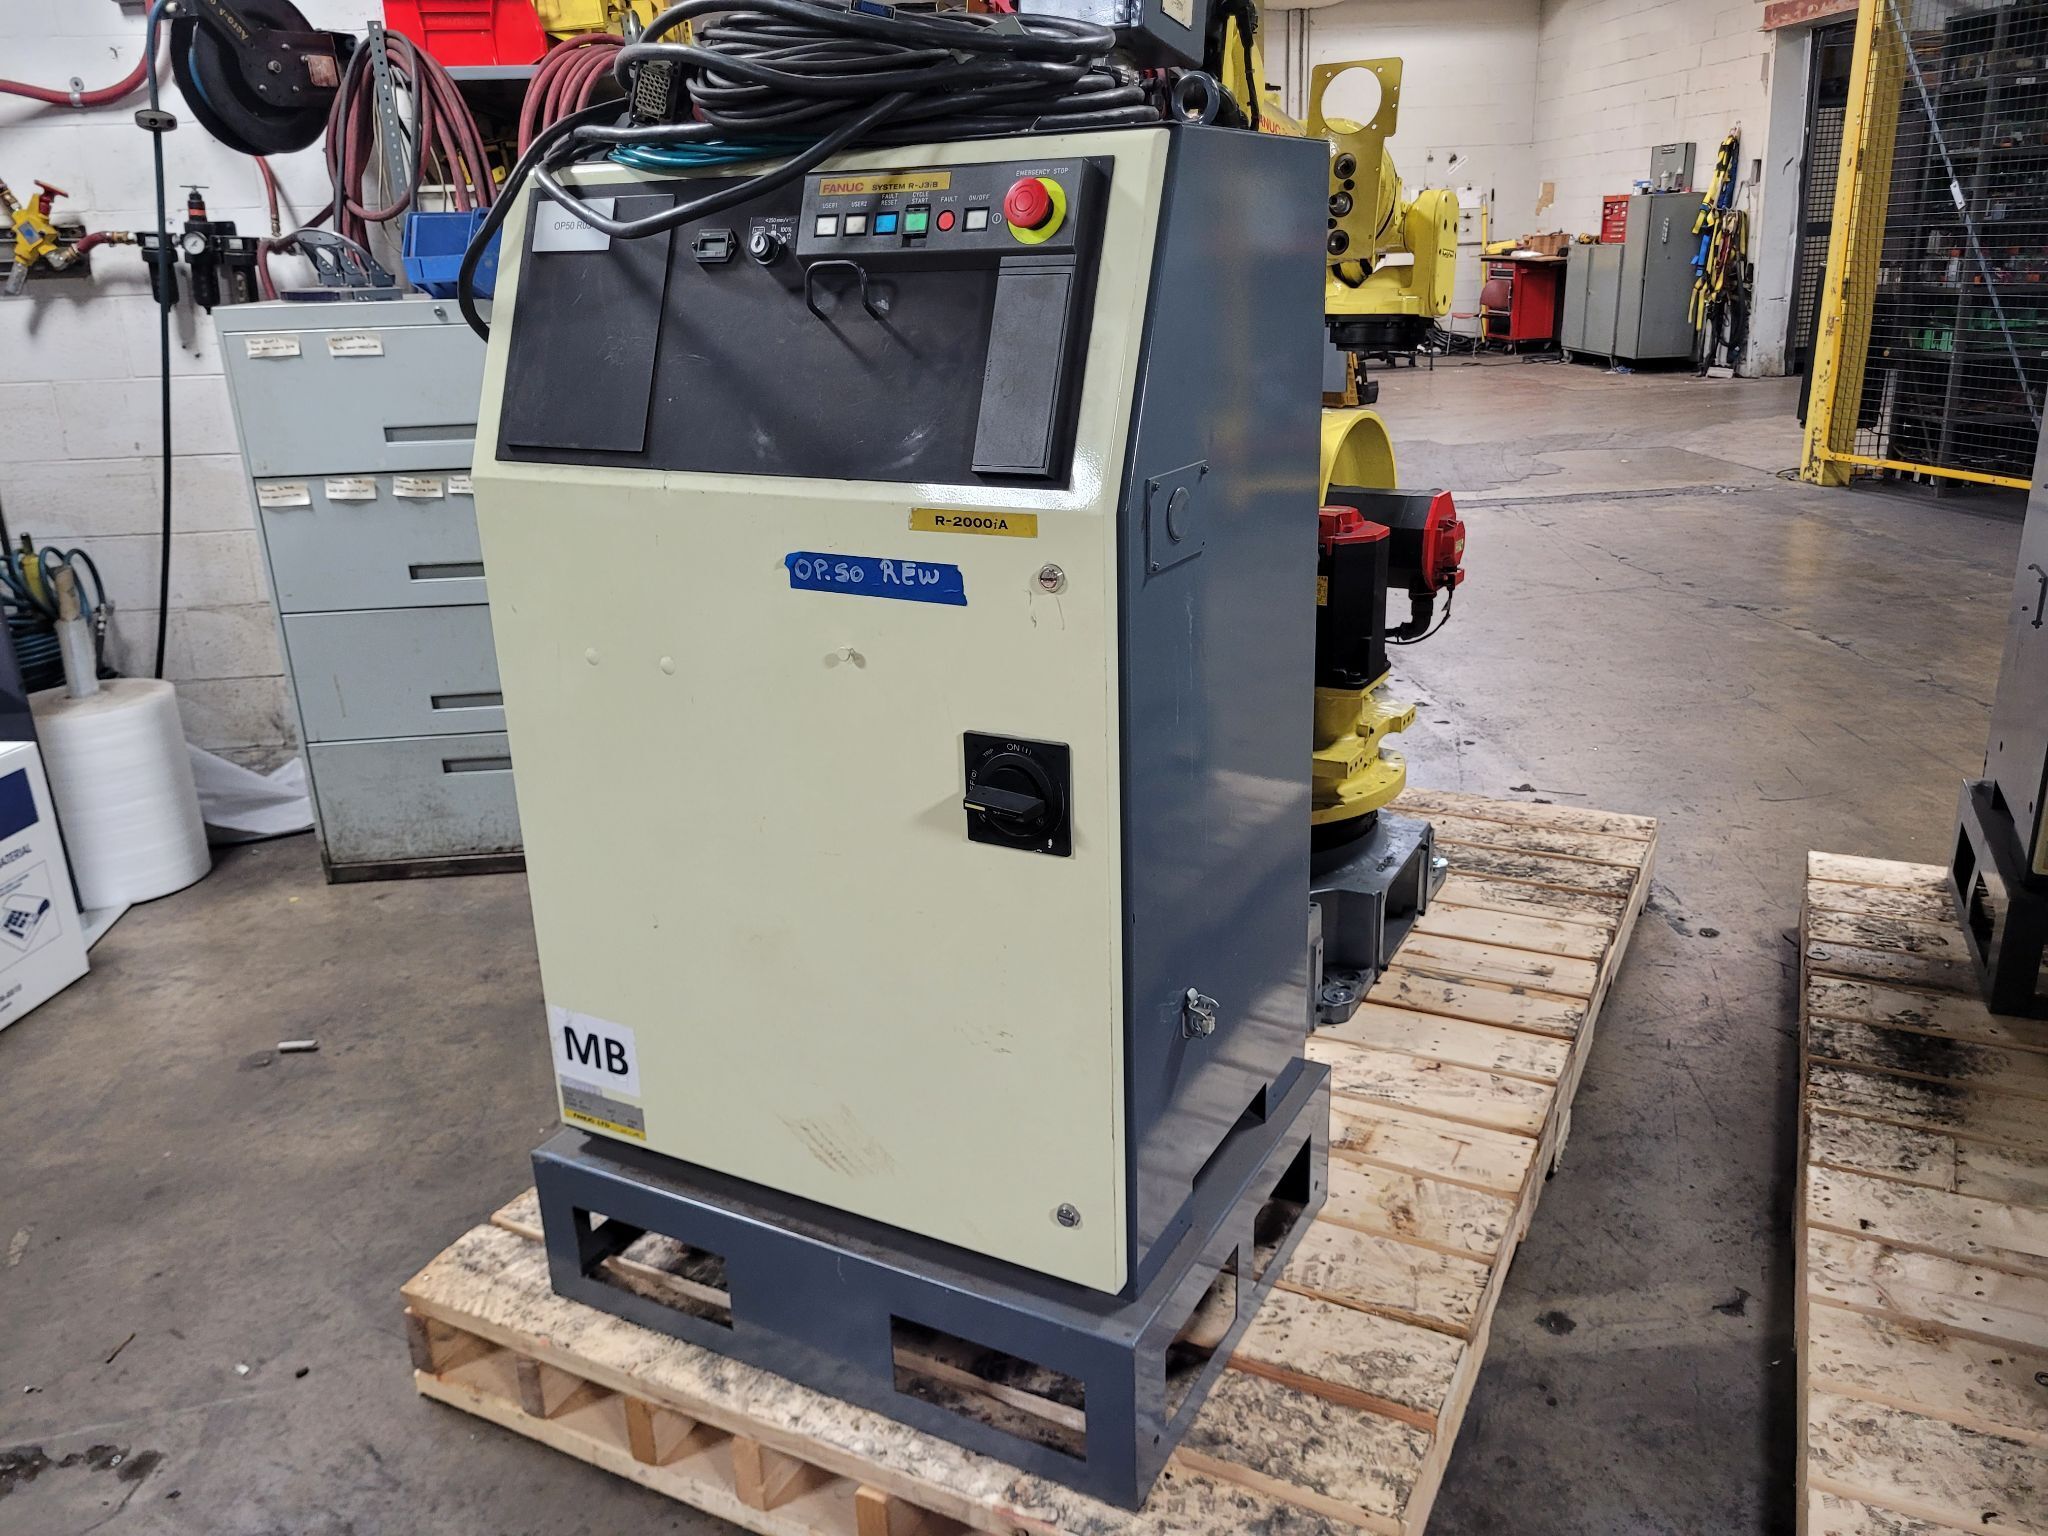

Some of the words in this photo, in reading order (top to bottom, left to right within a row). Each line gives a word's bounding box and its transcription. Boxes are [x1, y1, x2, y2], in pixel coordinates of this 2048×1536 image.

[1259, 114, 1281, 133] ANUC
[1016, 168, 1050, 177] EMERGENCY
[823, 183, 864, 194] FANUC
[554, 221, 574, 230] OP50
[935, 515, 1008, 530] R-2000iA
[880, 559, 940, 585] REW
[1007, 743, 1020, 751] ON
[564, 1026, 628, 1075] MB
